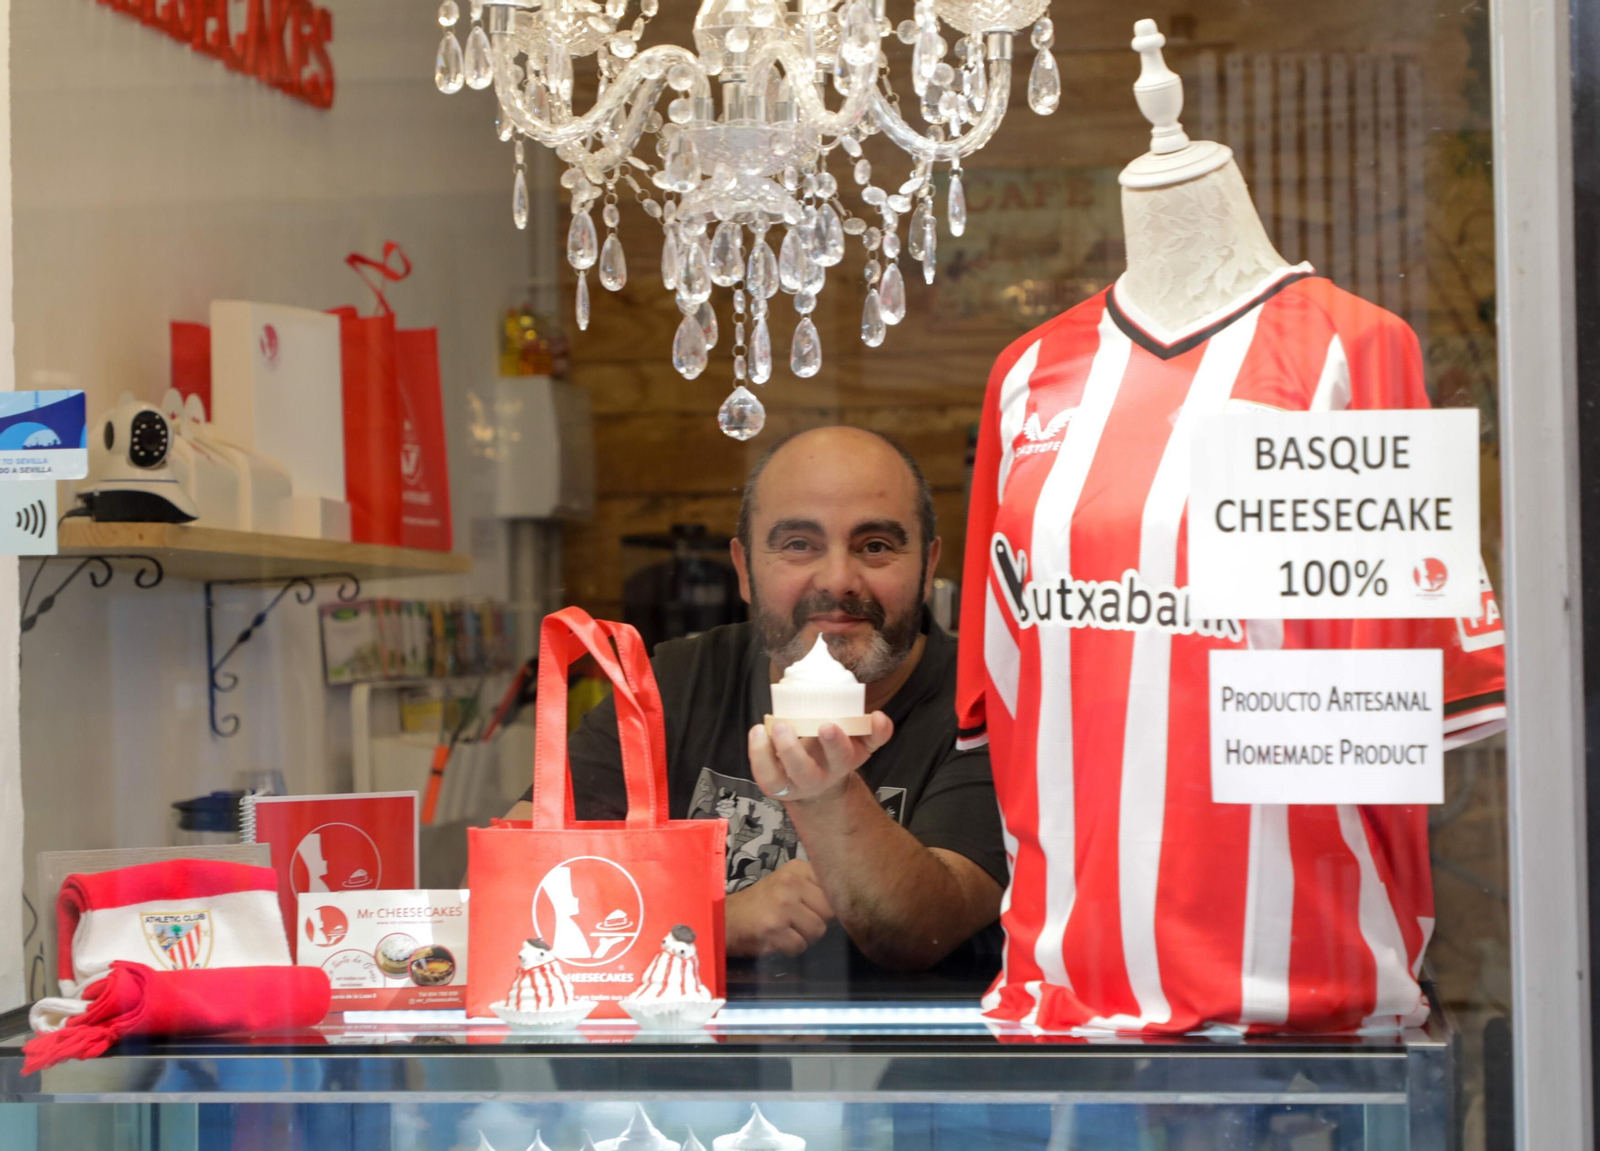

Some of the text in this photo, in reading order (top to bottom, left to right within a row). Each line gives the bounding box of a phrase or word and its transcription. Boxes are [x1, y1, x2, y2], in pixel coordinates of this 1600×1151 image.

[15, 457, 48, 465] SEVILLA
[1255, 436, 1410, 475] BASQUE
[19, 466, 52, 474] SEVILLA
[1215, 498, 1453, 532] CHEESECAKE
[1279, 559, 1388, 597] 100%
[1221, 686, 1432, 712] PRODUCTO ARTESANAL
[1225, 739, 1429, 765] HOMEMADE PRODUCT
[145, 913, 206, 924] ATHLETIC CLUB
[357, 906, 463, 919] Mr CHEESECAKES
